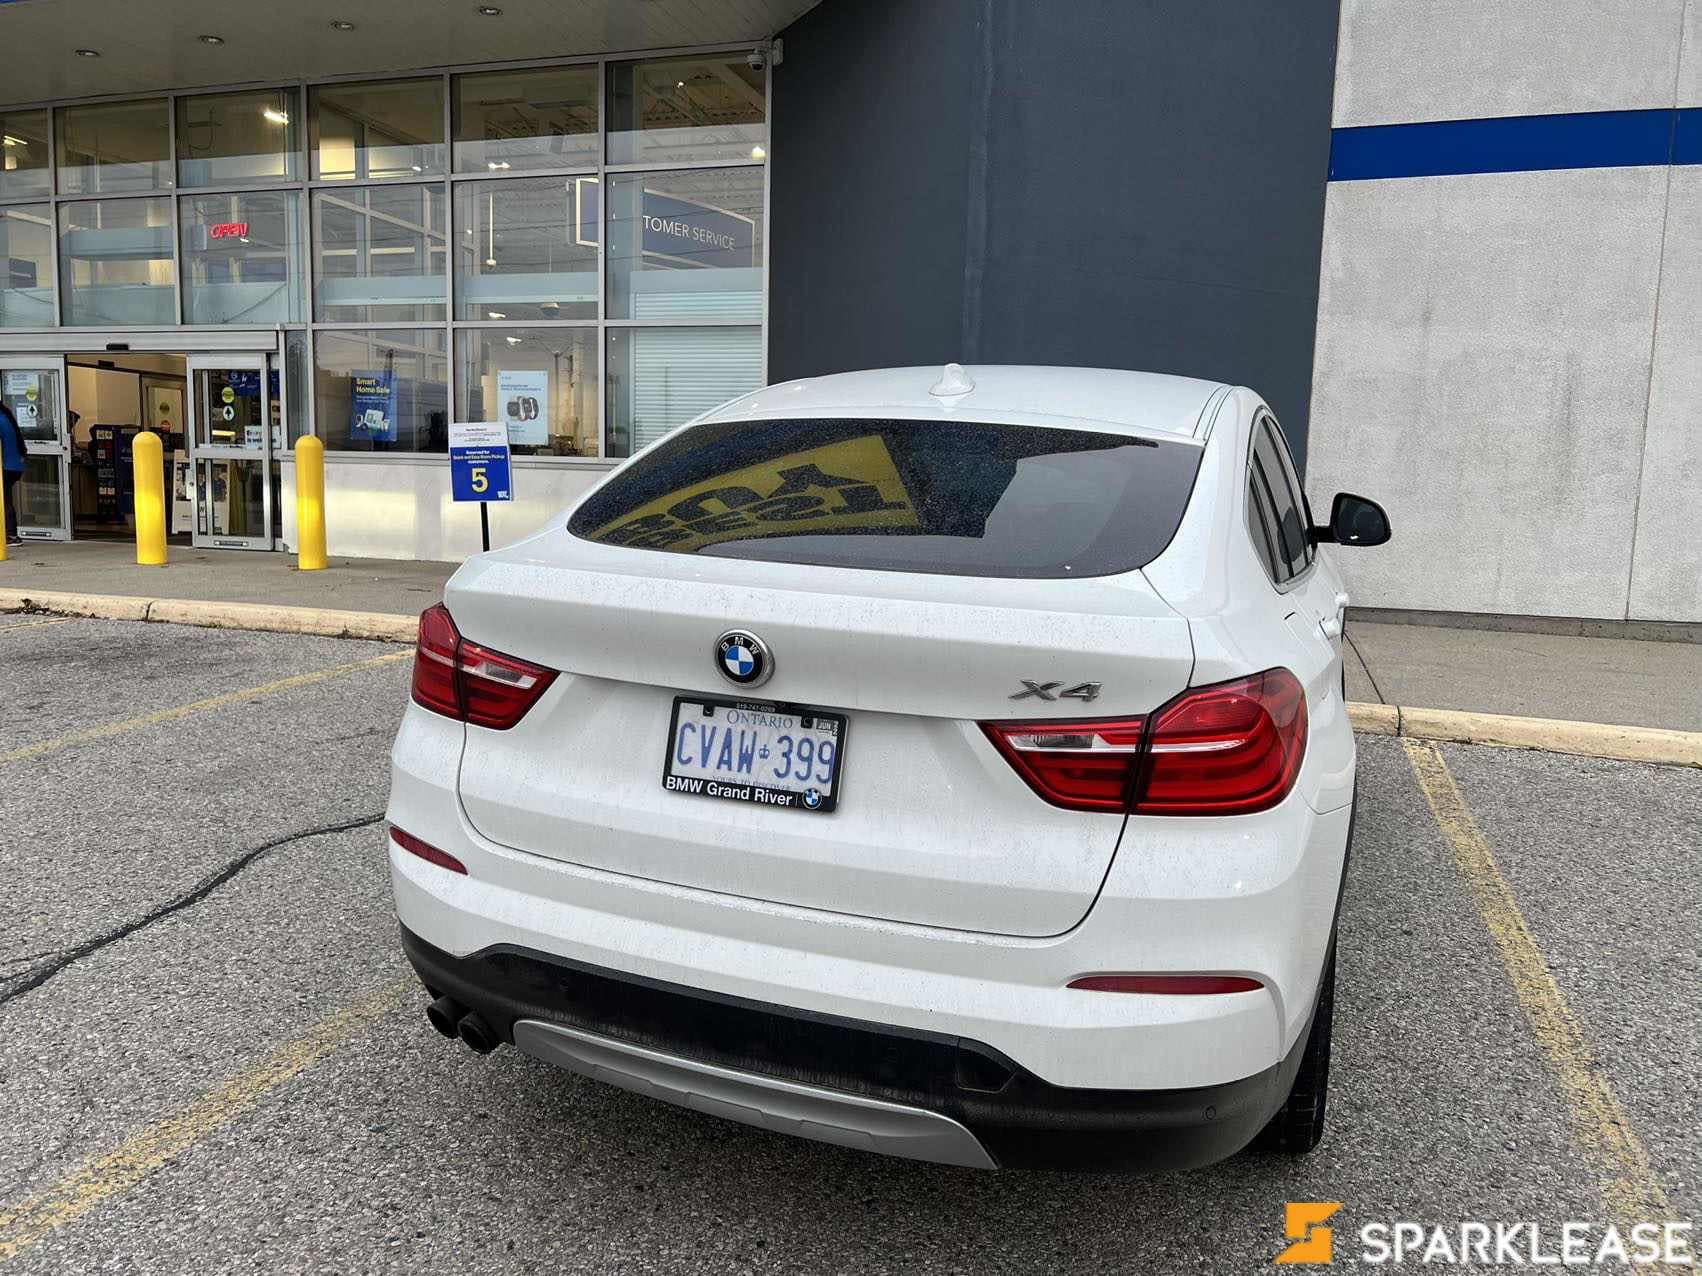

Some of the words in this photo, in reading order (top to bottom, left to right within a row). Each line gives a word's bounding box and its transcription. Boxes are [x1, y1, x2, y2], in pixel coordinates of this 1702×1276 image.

[210, 222, 248, 239] OPEN
[642, 215, 690, 238] TOMER
[692, 226, 737, 251] SERVICE
[471, 467, 489, 493] 5
[720, 635, 760, 655] BMW
[1007, 679, 1103, 702] X4
[676, 721, 758, 774] CVAW
[772, 734, 837, 785] 399
[665, 775, 704, 794] BMW
[706, 781, 751, 801] Grand
[753, 788, 793, 806] River
